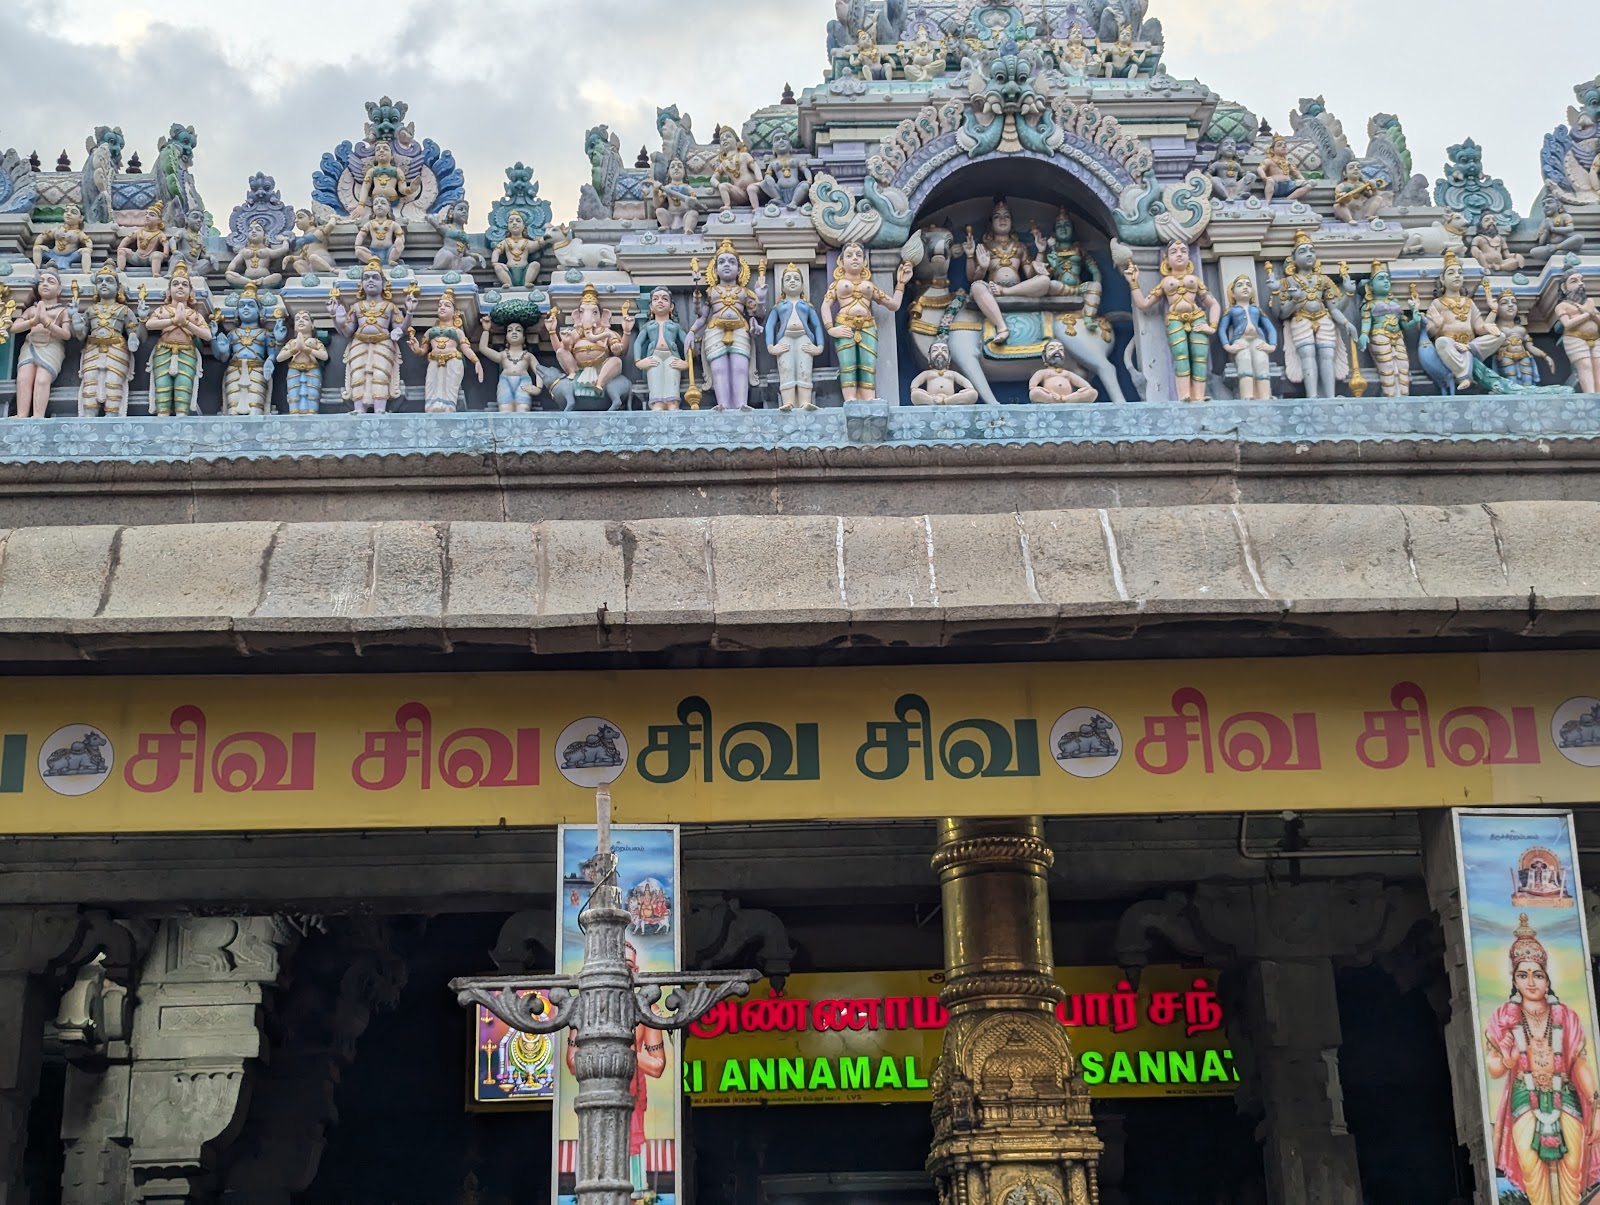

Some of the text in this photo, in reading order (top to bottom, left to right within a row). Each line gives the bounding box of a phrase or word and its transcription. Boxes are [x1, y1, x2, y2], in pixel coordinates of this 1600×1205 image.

[124, 704, 316, 793] சிவ
[352, 702, 540, 790] சிவ
[636, 695, 820, 783] சிவ
[855, 693, 1041, 780] சிவ
[1135, 687, 1322, 774] சிவ
[1355, 681, 1541, 769] சிவ
[719, 1056, 928, 1091] ANNAMAL
